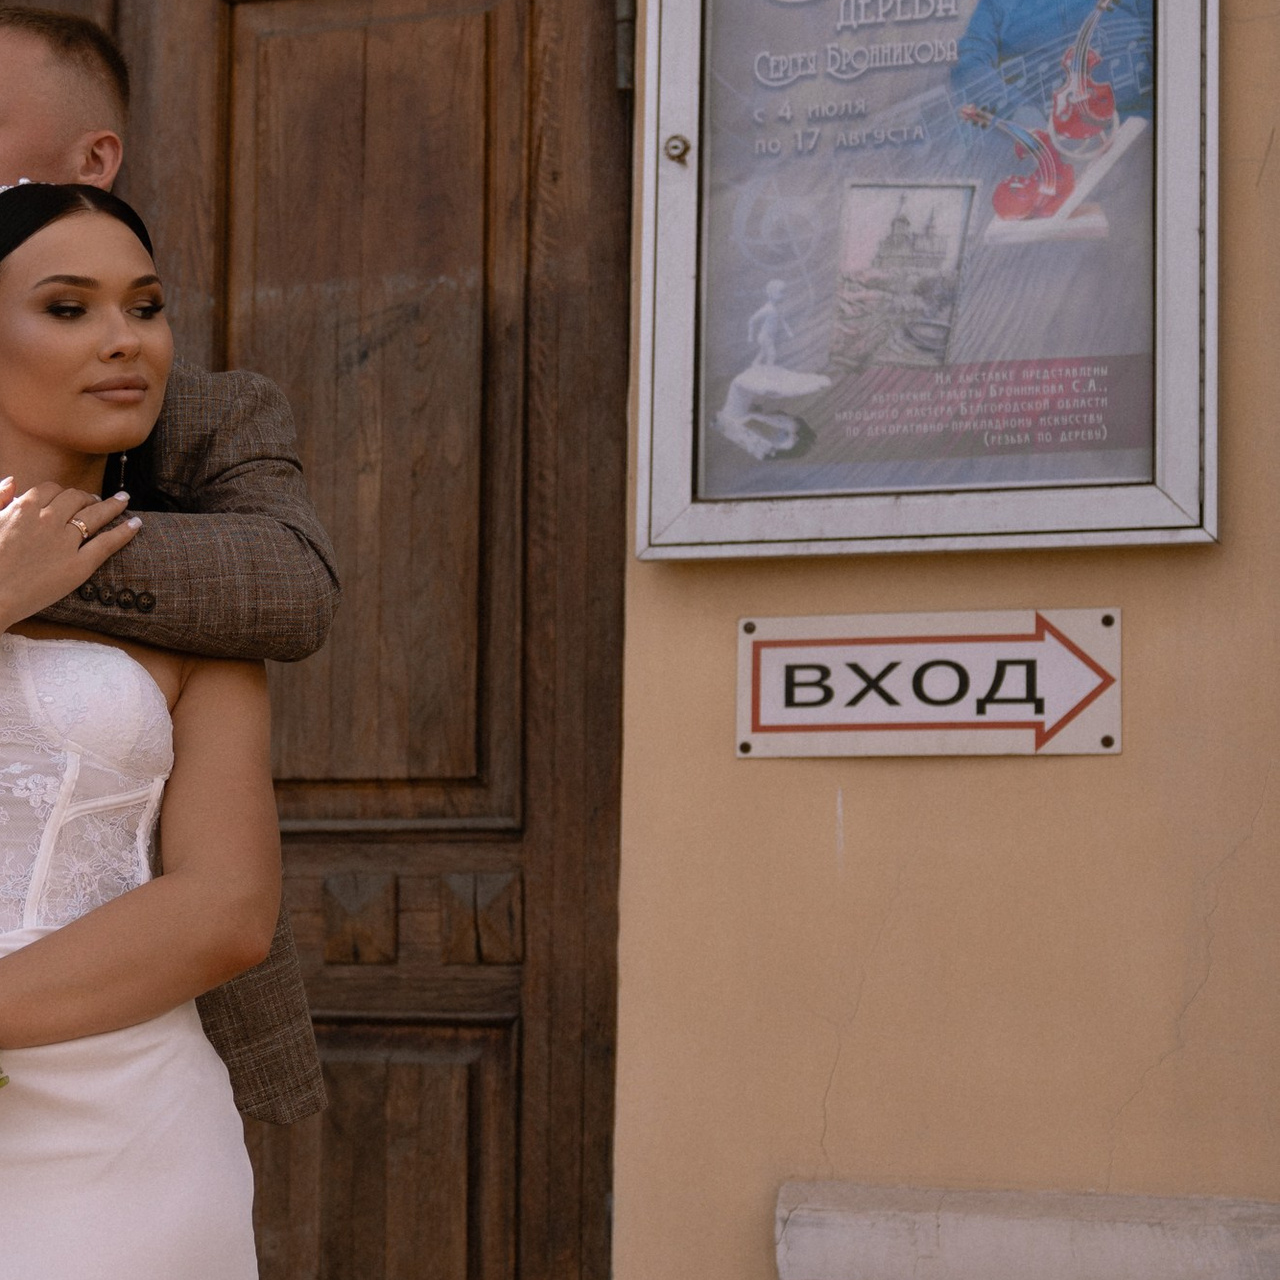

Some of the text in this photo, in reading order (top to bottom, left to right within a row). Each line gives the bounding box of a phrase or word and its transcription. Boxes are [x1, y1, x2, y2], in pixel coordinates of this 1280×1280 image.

[777, 97, 792, 120] 4
[794, 126, 820, 151] 17
[835, 125, 926, 147] АВГУСТА
[1057, 396, 1109, 410] ОБЛАСТИ
[1037, 432, 1053, 444] ПО
[1059, 423, 1109, 444] ДЕРЕВУ)
[783, 658, 1046, 717] ВХОД
